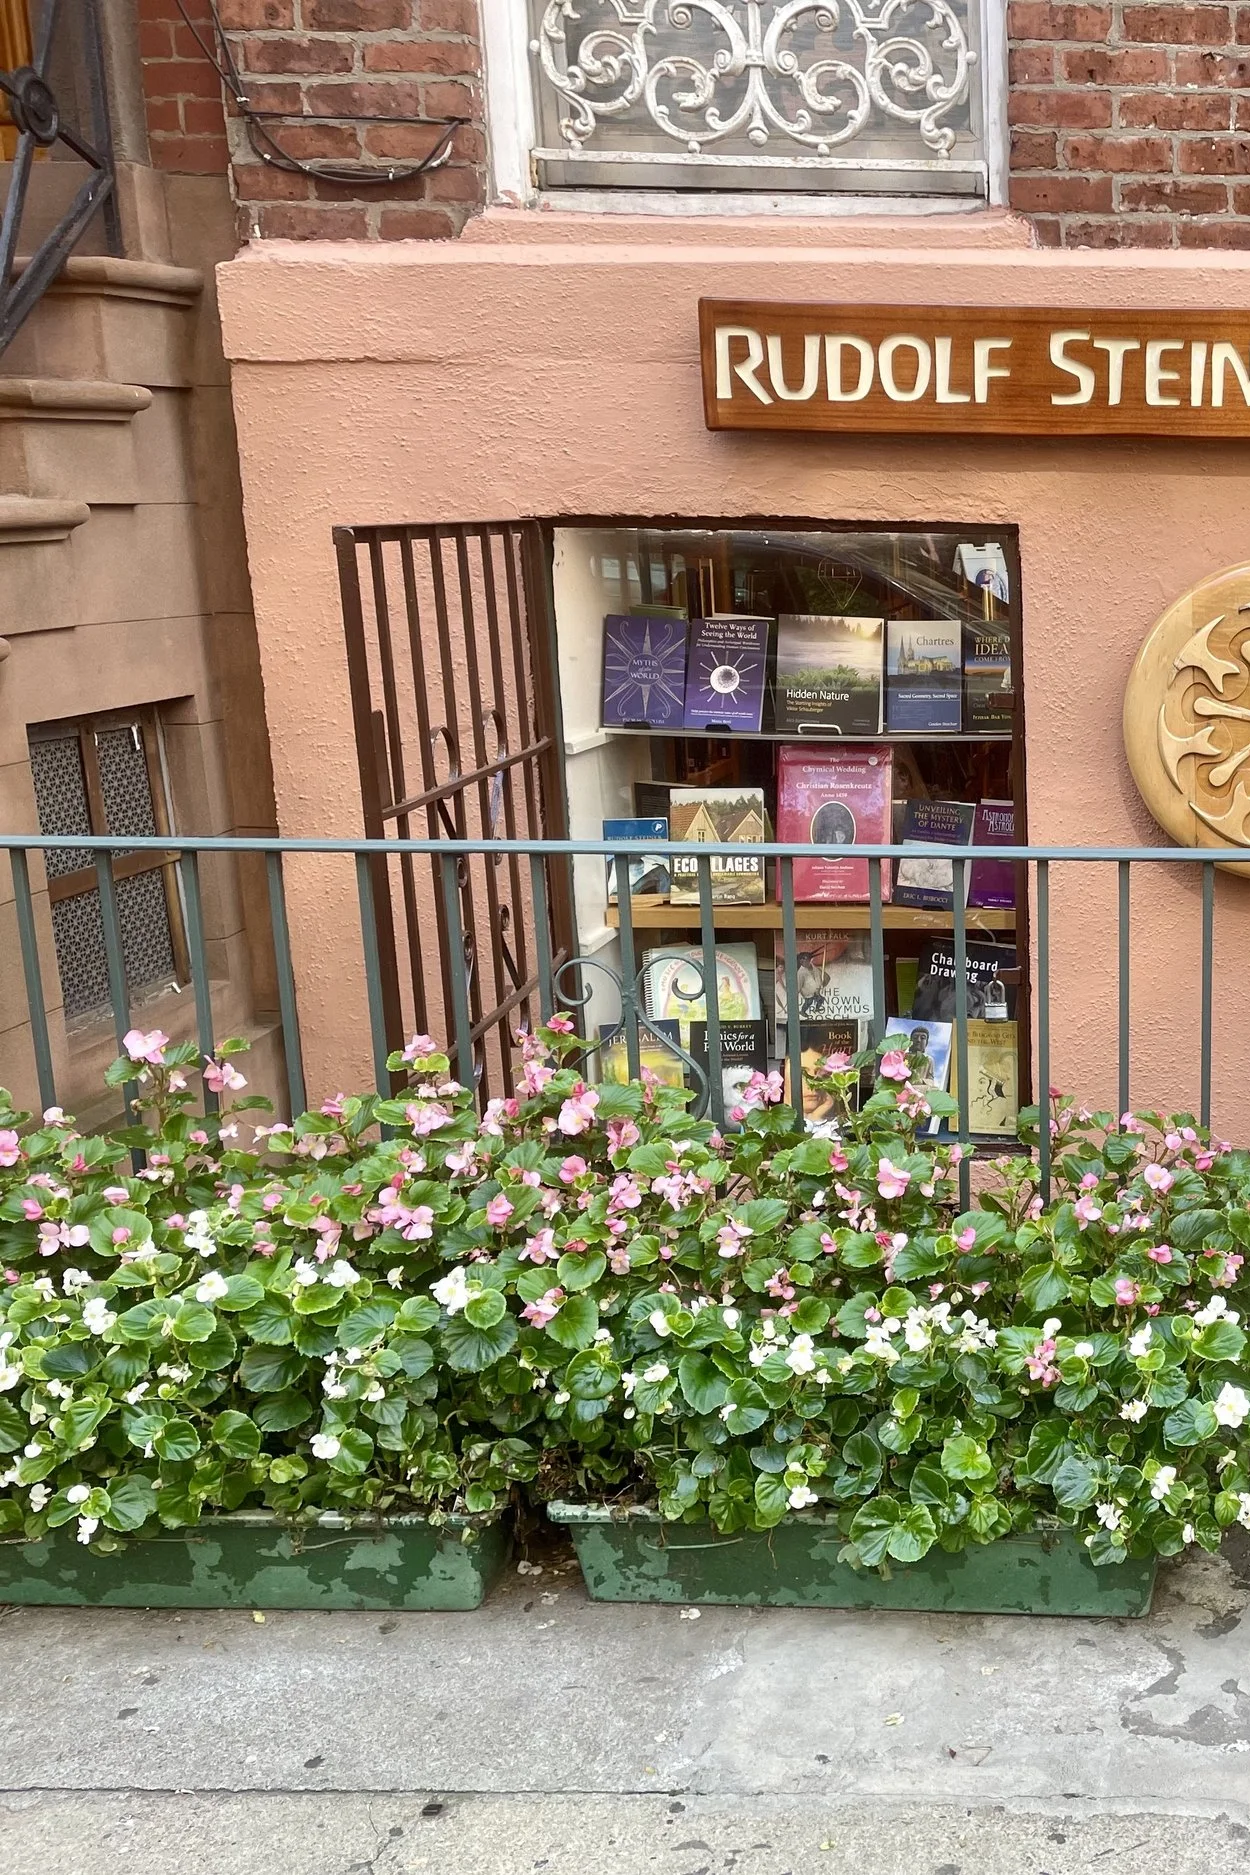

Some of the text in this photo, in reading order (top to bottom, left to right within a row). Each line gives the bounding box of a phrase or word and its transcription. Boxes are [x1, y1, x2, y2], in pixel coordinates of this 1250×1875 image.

[715, 325, 1013, 405] RUDOLF
[705, 622, 727, 630] Twelve
[729, 624, 746, 632] Ways
[701, 630, 723, 639] Seeing
[916, 636, 955, 646] Chartres
[975, 643, 1009, 655] IDEA
[632, 659, 658, 667] MYTHS
[630, 672, 660, 680] WORLD
[786, 689, 849, 701] Hidden Nature
[802, 765, 866, 774] Chymical Wedding
[919, 804, 960, 816] UNVEILING
[914, 811, 964, 824] THE MYSTERY
[918, 820, 956, 832] OF DANTE
[674, 856, 759, 873] ECOLLAGES
[903, 892, 916, 900] ERIC
[931, 953, 999, 972] Chaboard
[930, 964, 979, 983] Drawng
[816, 988, 840, 996] THE
[808, 1005, 870, 1015] RONYMUS
[736, 1032, 749, 1043] for
[828, 1031, 852, 1040] Book
[724, 1041, 755, 1052] World
